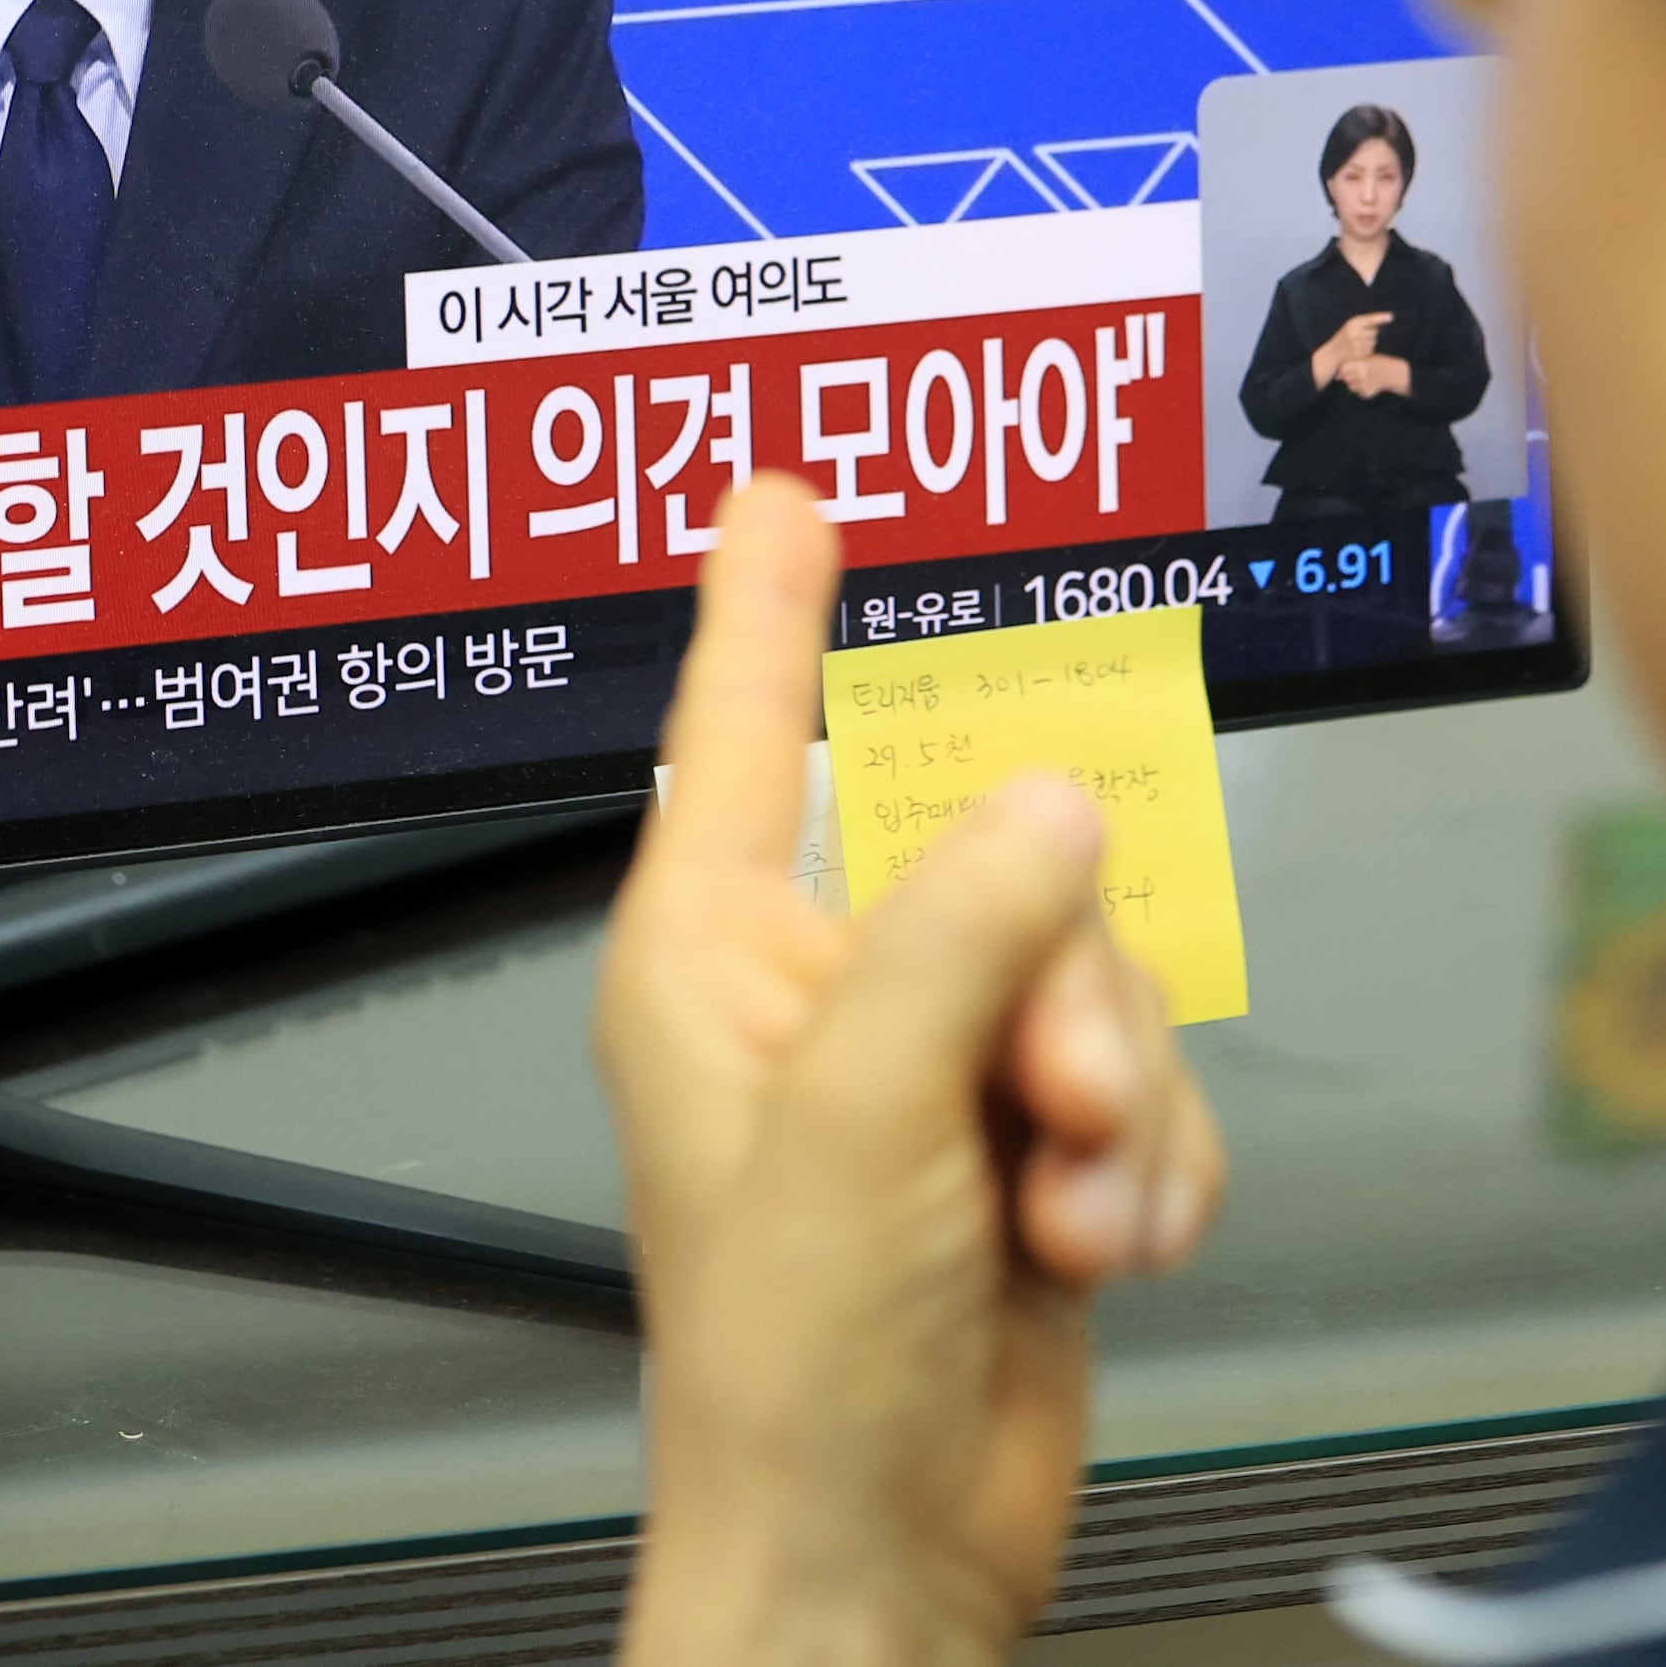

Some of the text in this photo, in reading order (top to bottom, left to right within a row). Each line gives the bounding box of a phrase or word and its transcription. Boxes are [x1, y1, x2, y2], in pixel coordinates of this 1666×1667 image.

[438, 255, 850, 344] 이 시각 서울 여의도
[135, 388, 490, 615] 것인지
[528, 362, 752, 565] 의견
[797, 312, 1167, 526] 모아야"
[860, 541, 1393, 641] 원-유로 1680.04 6.91
[336, 636, 446, 711] 항의
[464, 623, 575, 694] 방문
